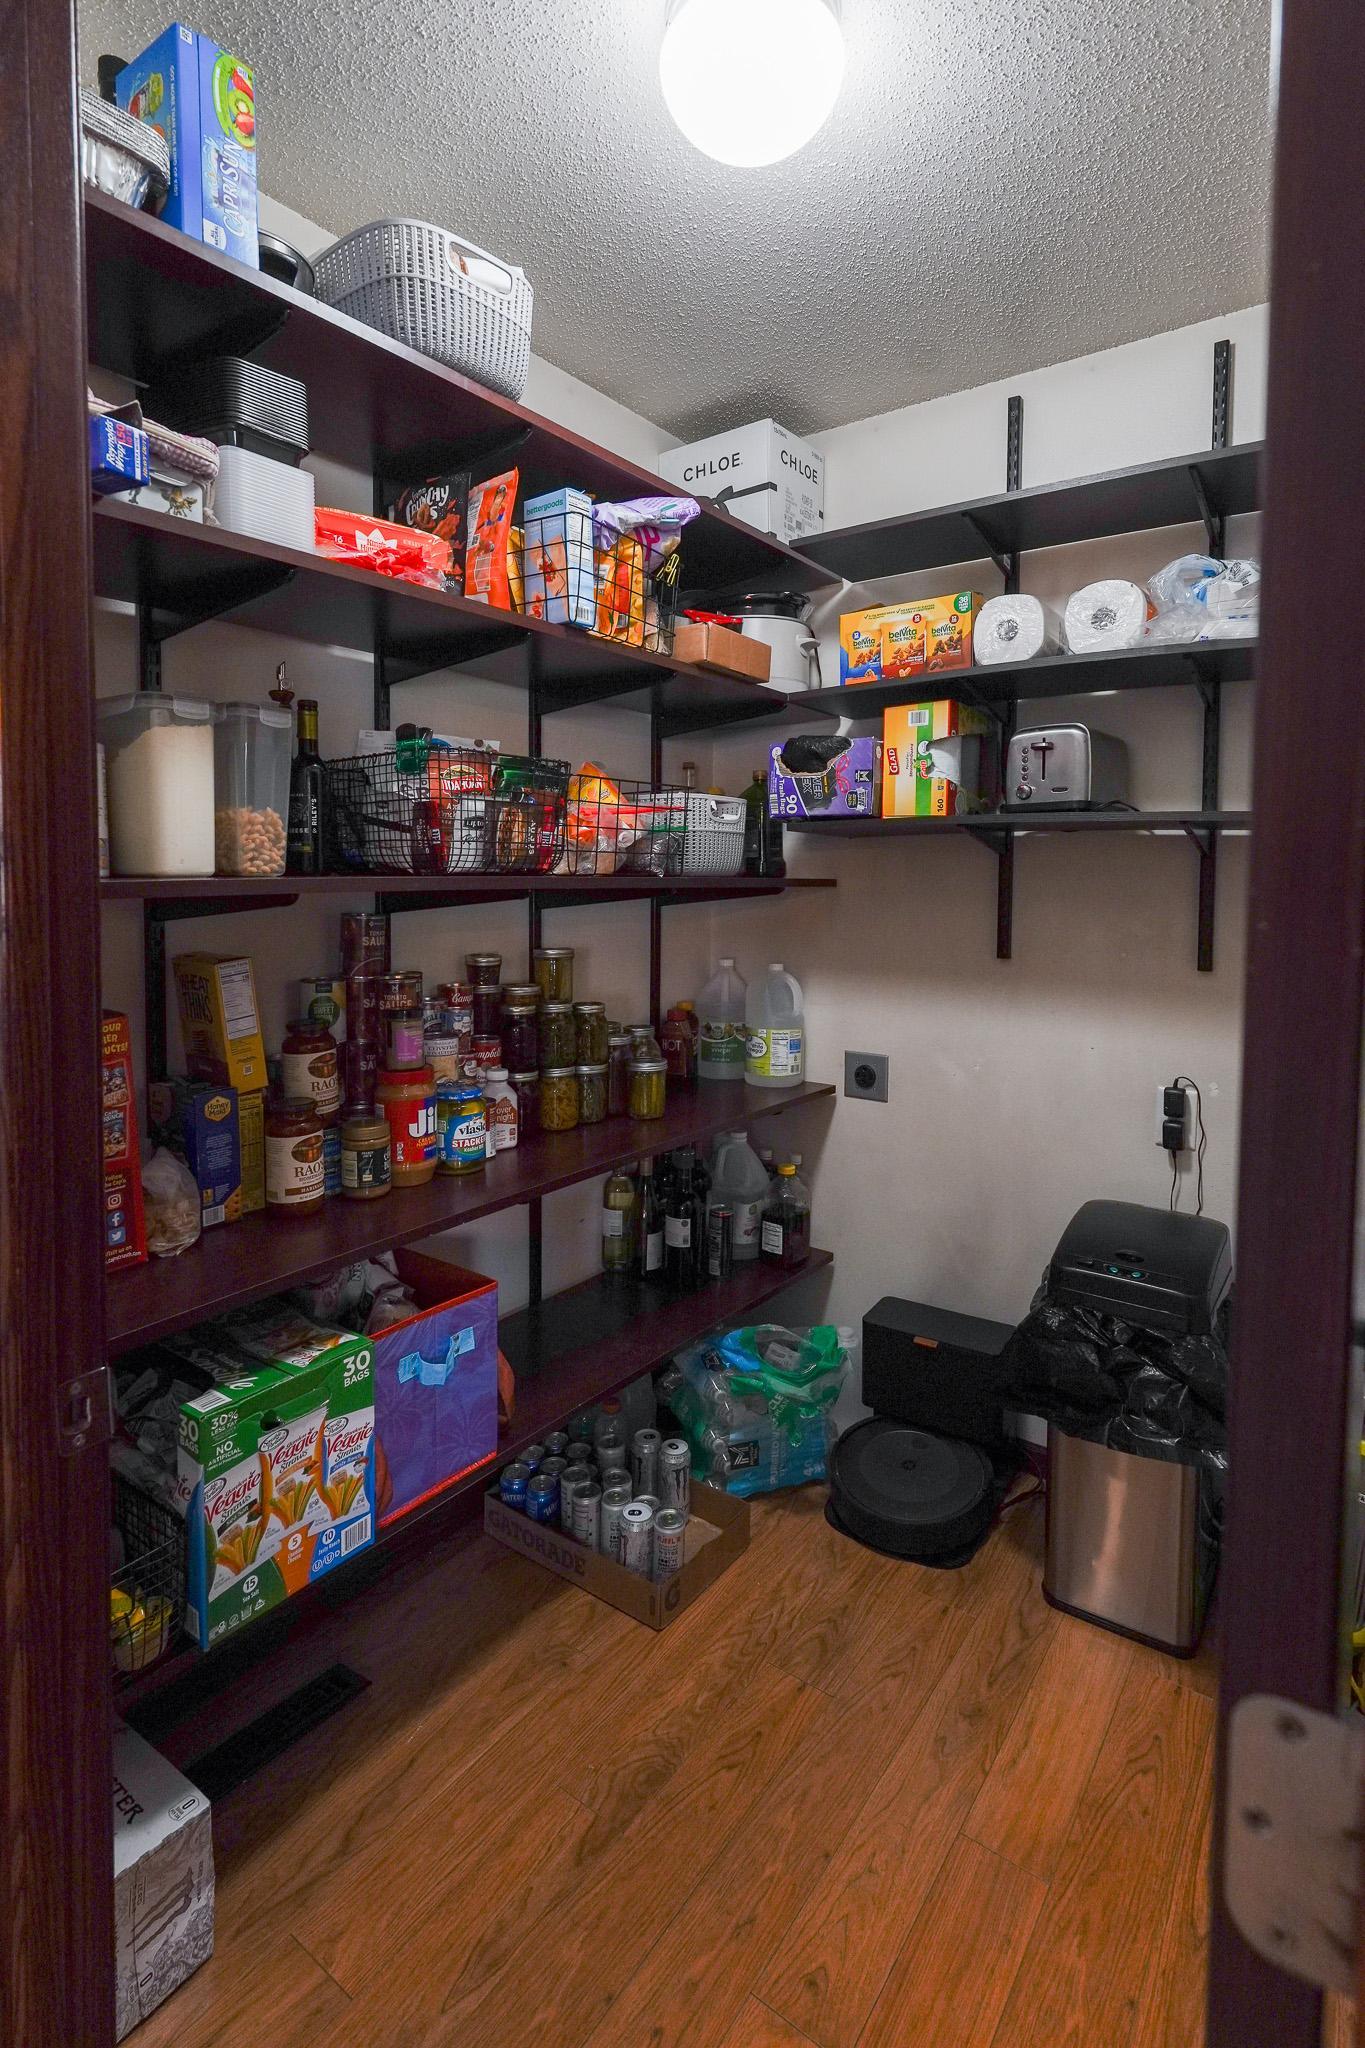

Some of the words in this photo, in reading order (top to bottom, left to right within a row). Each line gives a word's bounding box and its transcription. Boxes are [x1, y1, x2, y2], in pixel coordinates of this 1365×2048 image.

[104, 418, 118, 465] Reynolds
[115, 443, 128, 472] Wrap
[684, 452, 740, 482] CHLOE
[780, 450, 818, 484] CHLOE
[526, 498, 564, 516] bettergoods
[333, 534, 343, 543] 16
[958, 596, 968, 604] 36
[890, 749, 898, 774] GLAD
[786, 794, 798, 814] 90
[662, 1040, 681, 1052] HOT
[207, 1101, 230, 1114] Honey
[496, 1106, 512, 1115] over
[496, 1112, 514, 1122] night
[343, 1351, 370, 1378] 30
[344, 1368, 370, 1388] BAGS
[179, 1414, 198, 1442] 30
[211, 1410, 238, 1430] 30%
[211, 1425, 226, 1436] LESS
[227, 1420, 238, 1430] FAT
[216, 1441, 234, 1456] NO
[268, 1430, 318, 1472] Veggie
[327, 1427, 372, 1458] Veggie
[208, 1448, 242, 1467] ARTIFICIAL
[280, 1452, 308, 1474] Straws
[335, 1446, 362, 1462] Straws
[204, 1474, 261, 1524] Veggie
[221, 1496, 251, 1523] Straws
[324, 1531, 334, 1541] 10
[488, 1509, 585, 1577] GATORADE
[244, 1579, 256, 1590] 15
